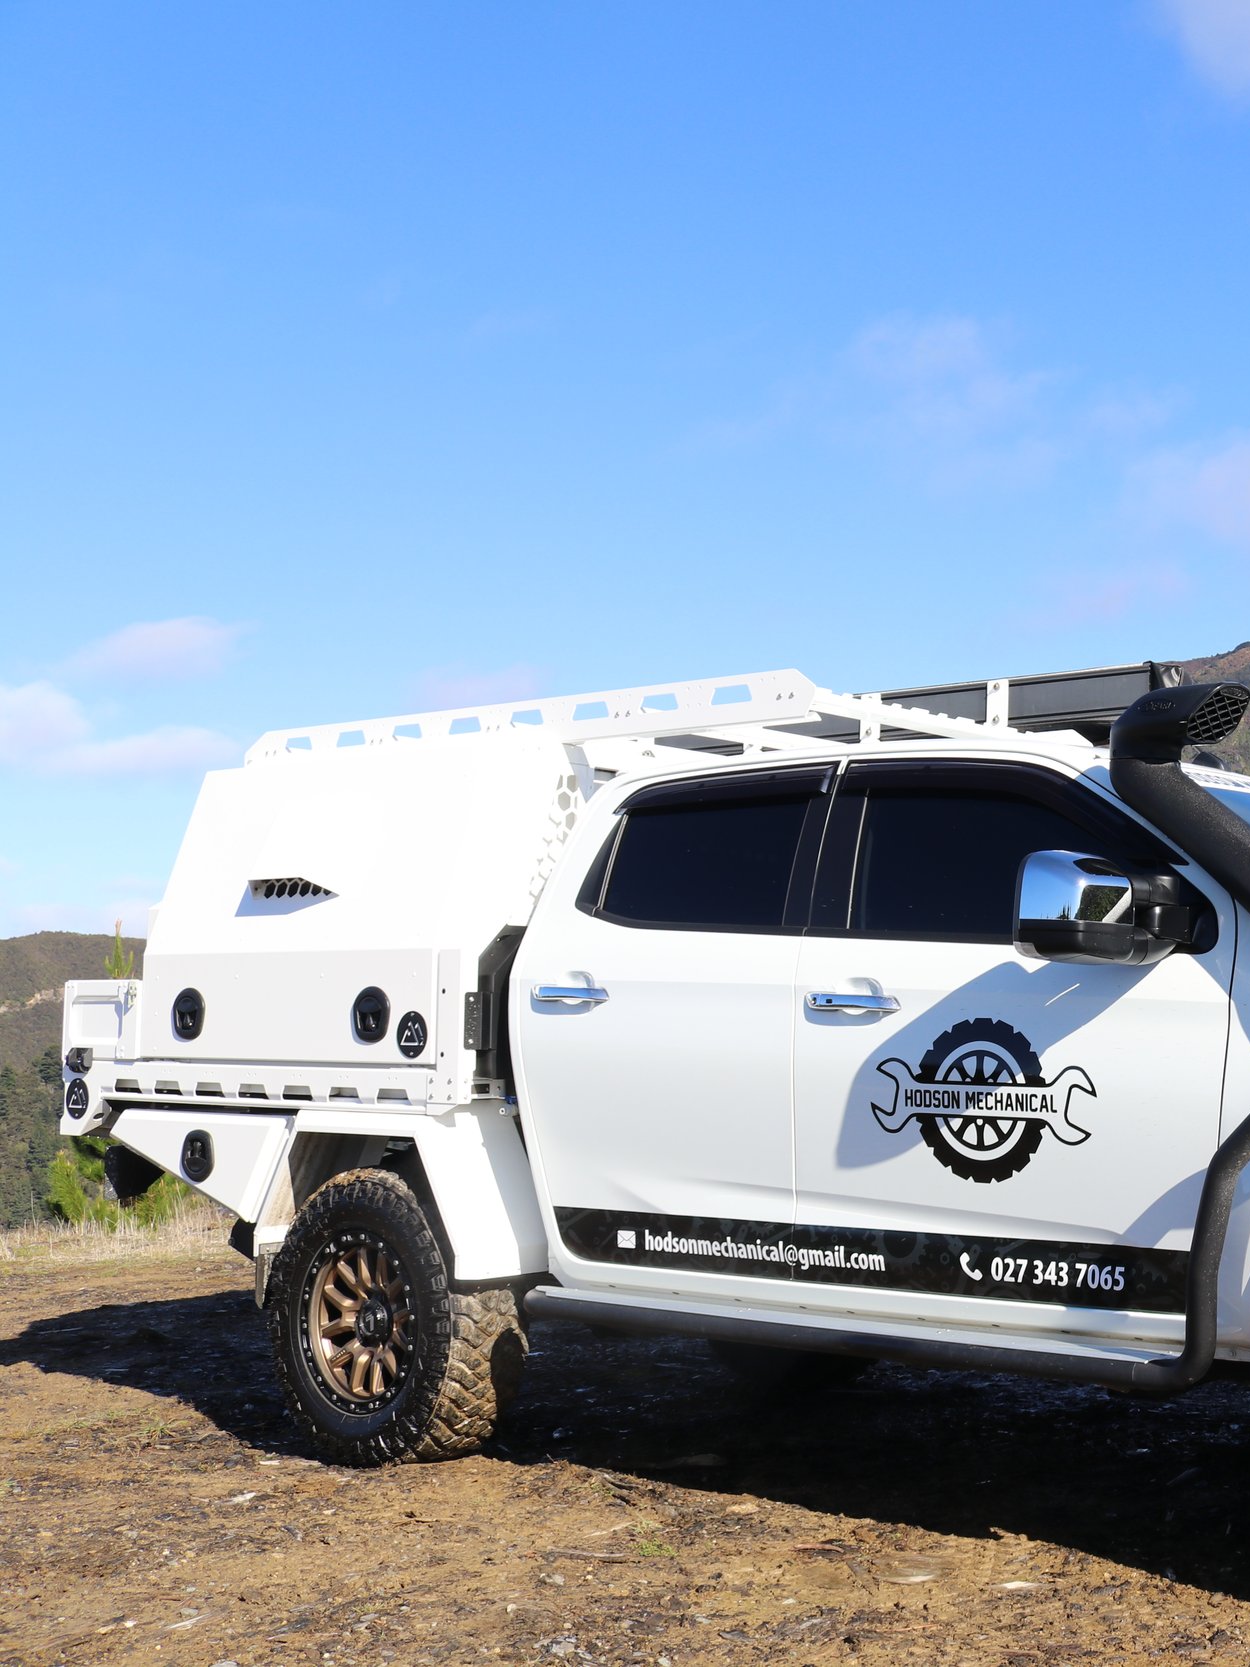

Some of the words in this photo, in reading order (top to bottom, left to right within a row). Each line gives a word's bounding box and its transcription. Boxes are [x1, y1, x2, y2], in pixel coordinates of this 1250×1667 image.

[904, 1088, 961, 1110] HODSON
[965, 1091, 1058, 1114] MECHANICAL
[644, 1229, 886, 1271] hodsonmechanical@gmail.com
[991, 1256, 1028, 1283] 027
[1032, 1259, 1069, 1287] 343
[1075, 1262, 1125, 1291] 7065
